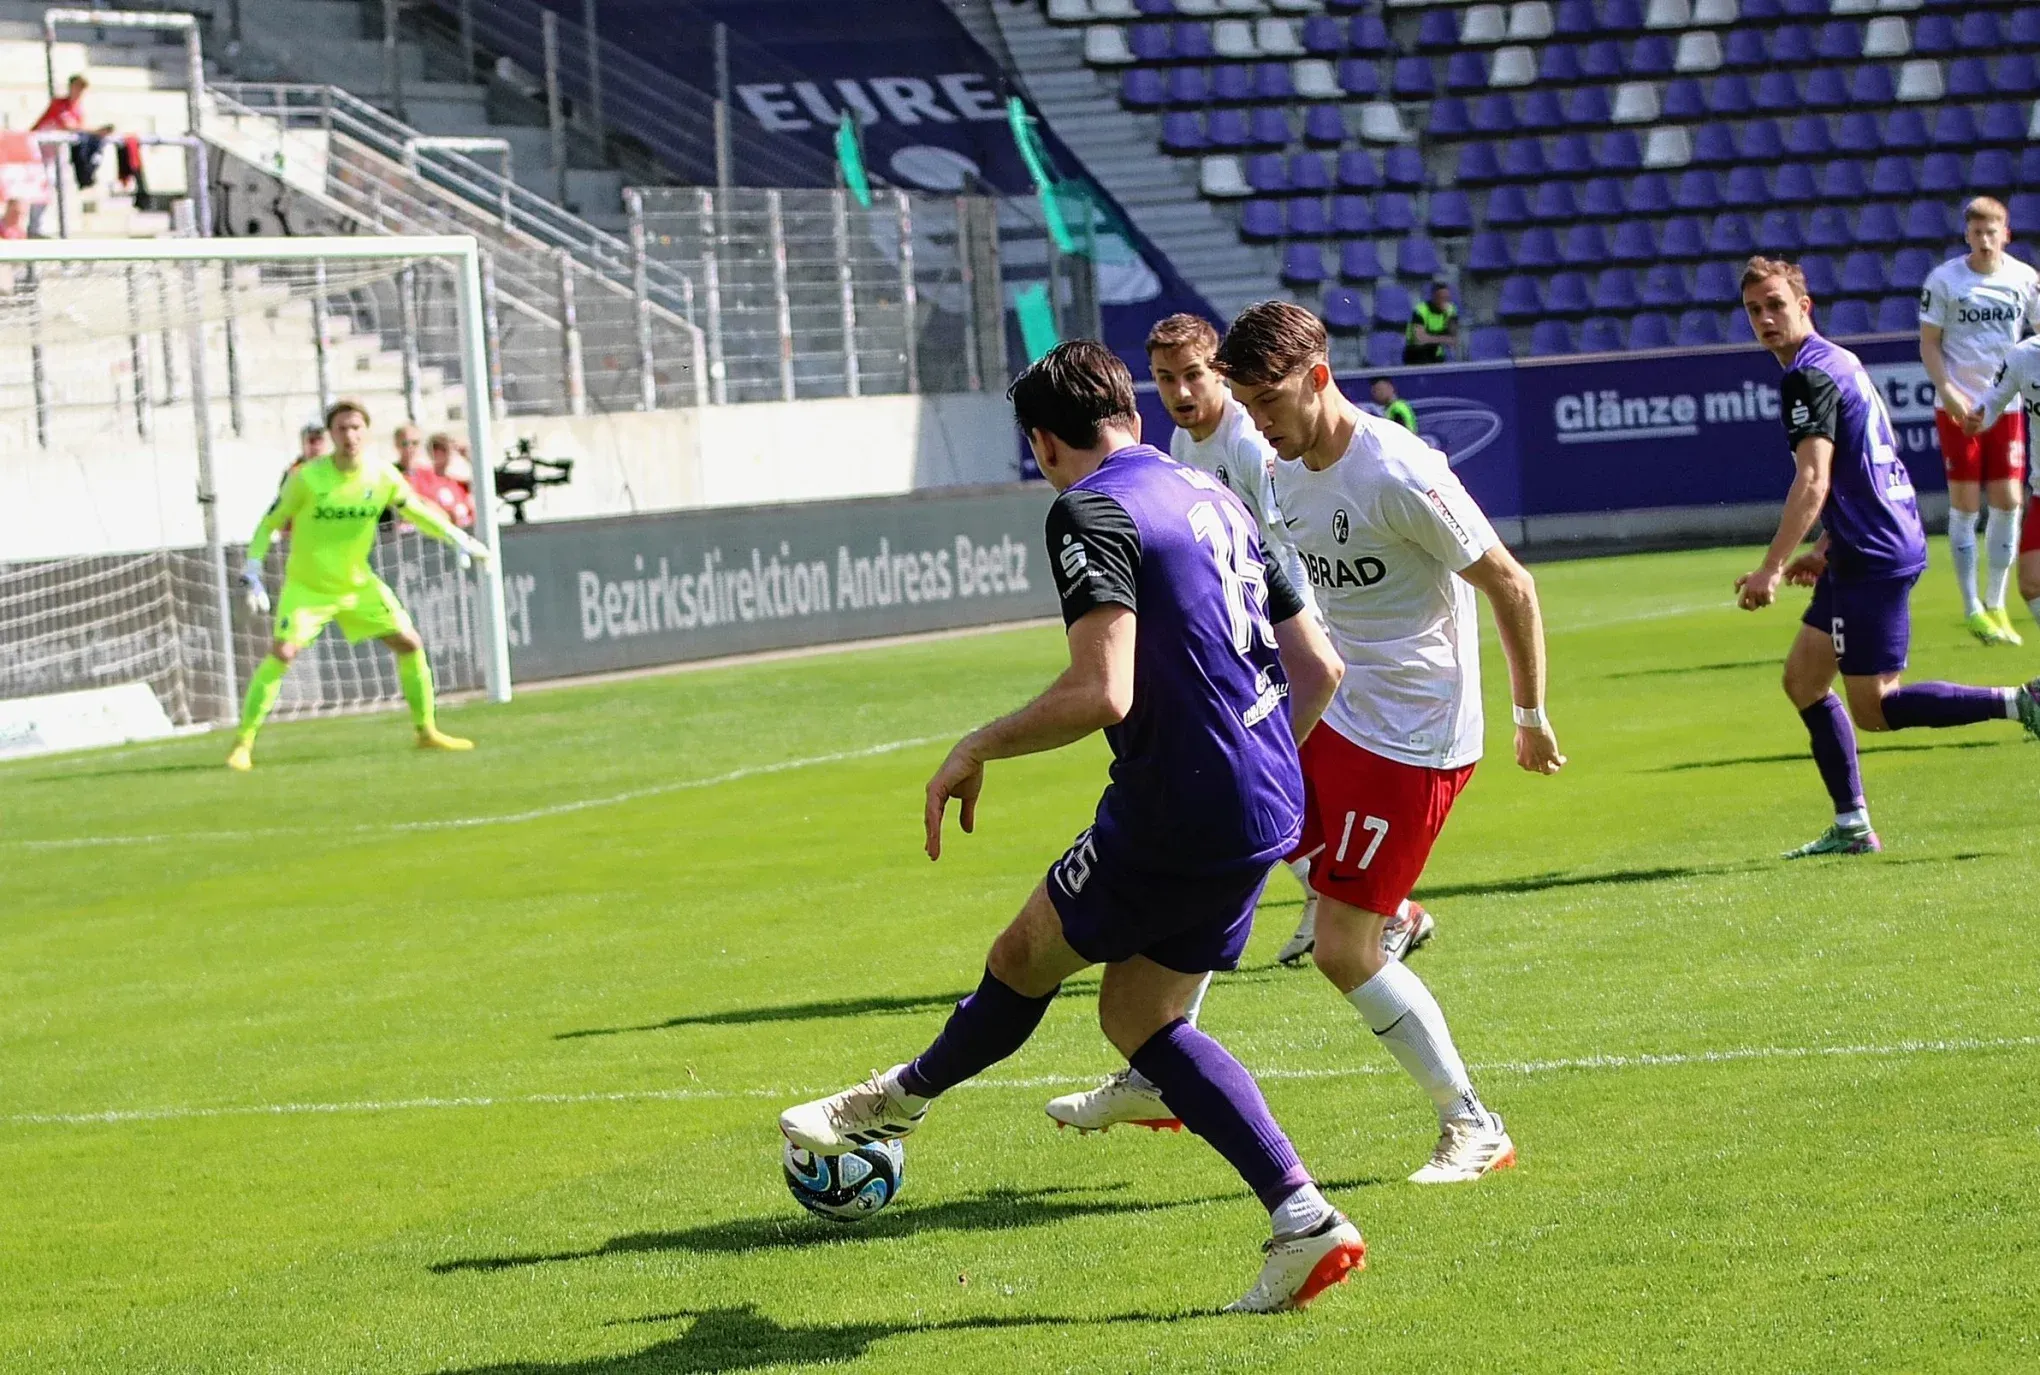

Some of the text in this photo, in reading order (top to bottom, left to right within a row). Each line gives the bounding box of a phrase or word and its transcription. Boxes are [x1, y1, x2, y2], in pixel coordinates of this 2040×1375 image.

[735, 72, 1010, 132] EURE
[1555, 380, 1781, 430] Glänze mit
[577, 540, 831, 642] Bezirksdirektion
[836, 535, 953, 610] Andreas
[955, 533, 1031, 597] Beetz
[1299, 550, 1387, 588] OBRAD
[1335, 810, 1389, 870] 17
